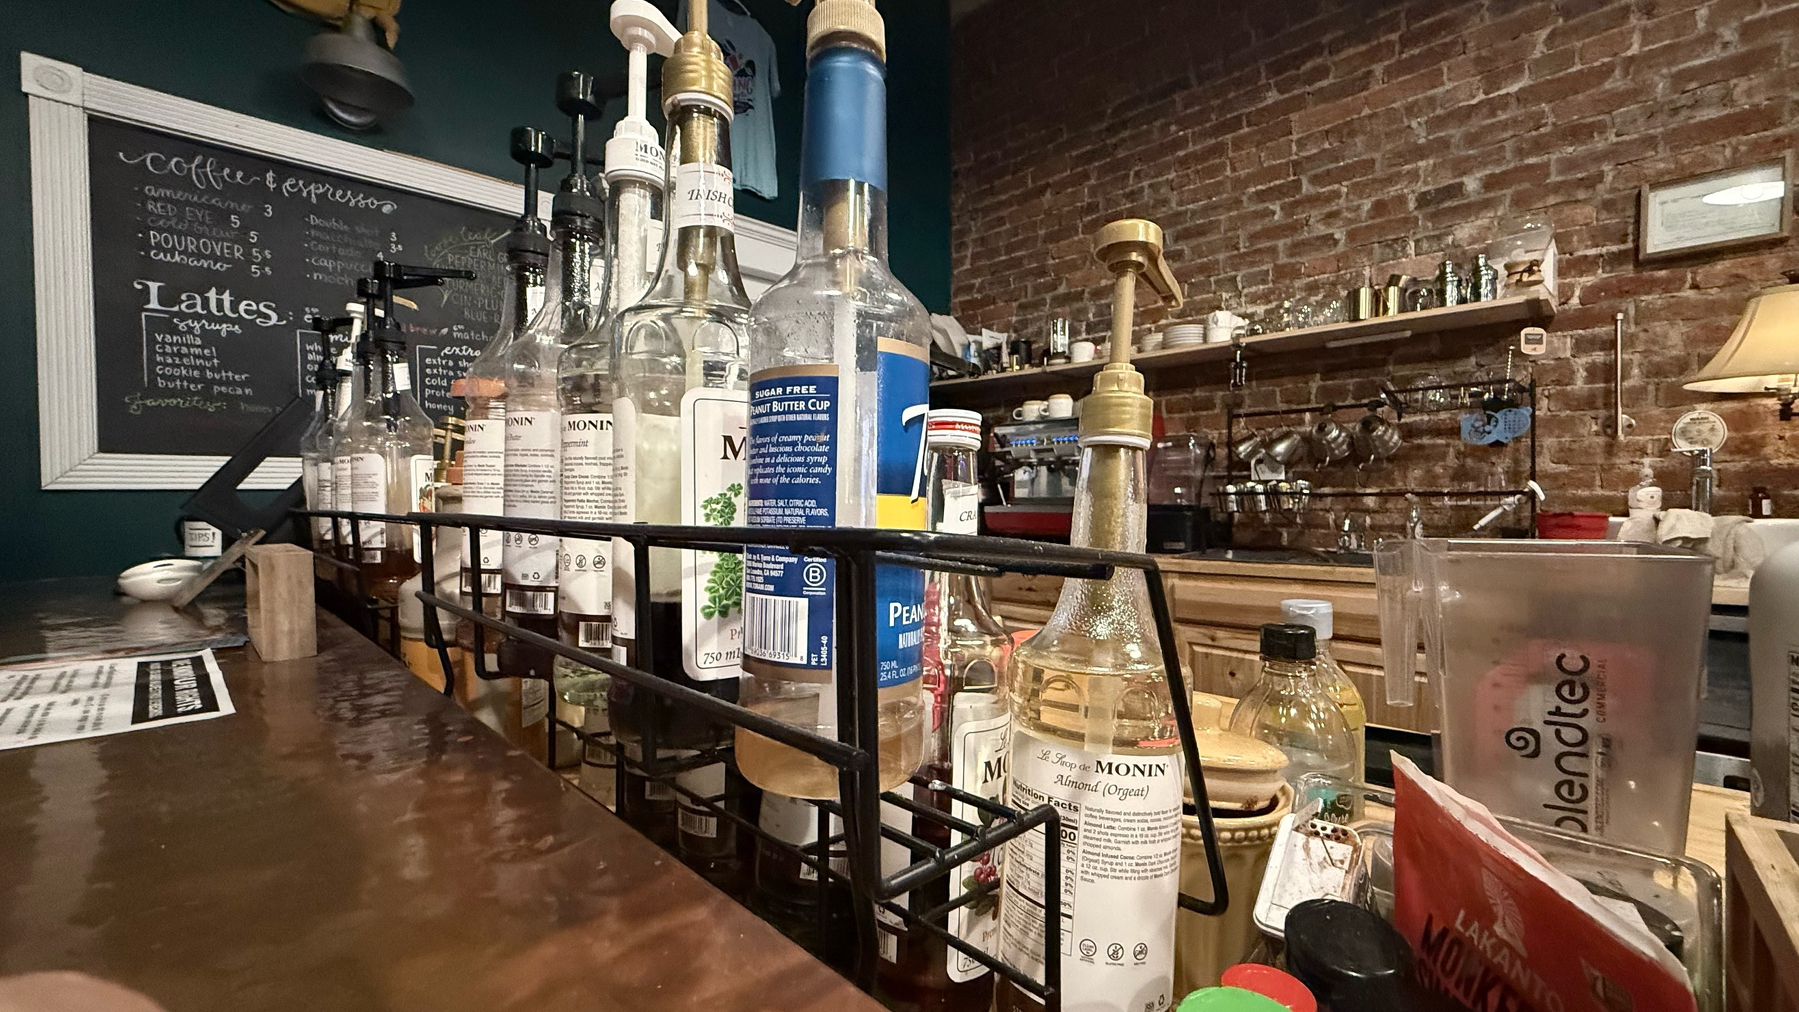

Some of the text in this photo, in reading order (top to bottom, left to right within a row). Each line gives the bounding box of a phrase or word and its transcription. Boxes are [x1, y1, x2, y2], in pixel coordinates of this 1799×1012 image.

[282, 176, 397, 209] espresso
[145, 186, 273, 217] americano 3
[148, 201, 240, 228] RED EYE 5
[250, 231, 259, 242] 5
[390, 232, 397, 241] 3
[150, 249, 232, 271] cubano
[377, 252, 383, 261] 4
[311, 257, 373, 273] cappucci
[314, 273, 355, 286] moch
[173, 317, 242, 337] syrups
[154, 333, 202, 346] vanilla
[453, 331, 494, 341] match
[156, 344, 217, 357] caramel
[156, 354, 220, 368] hazelnut
[425, 357, 453, 366] extra
[156, 365, 250, 381] cookie butter
[425, 367, 454, 376] extra
[157, 378, 252, 396] butter pecan
[425, 377, 447, 386] cold
[425, 388, 452, 398] prote
[755, 385, 816, 399] SUGAR FREE
[425, 401, 454, 415] honey
[772, 401, 805, 412] BUTTER
[808, 399, 830, 410] CUP
[507, 416, 533, 427] ONIN
[467, 424, 484, 432] NIN
[771, 432, 778, 444] of
[779, 435, 802, 443] creamy
[769, 444, 793, 453] luscious
[794, 443, 830, 452] chocolate
[902, 403, 929, 505] T
[776, 454, 804, 463] delicious
[806, 456, 828, 464] syrup
[776, 464, 785, 473] the
[787, 465, 808, 473] iconic
[809, 464, 832, 475] candy
[772, 474, 821, 485] of the calories.
[959, 510, 976, 522] CRA
[776, 555, 798, 564] Company
[809, 568, 821, 582] B
[889, 602, 924, 627] PEAN
[704, 652, 722, 665] 750
[769, 652, 790, 660] 69315
[880, 660, 898, 670] 750 ML
[1596, 658, 1608, 724] COMMERCIAL
[1037, 749, 1167, 777] Le Sirop de MONIN
[1054, 774, 1150, 801] Almond (Orgeat)
[1013, 777, 1079, 812] Nutrition Facts
[1085, 805, 1104, 814] Naturally
[1084, 820, 1102, 828] Almond
[1099, 815, 1122, 823] beverages,
[1061, 829, 1076, 840] 00
[1082, 849, 1100, 857] Almond
[1091, 871, 1109, 879] whipped
